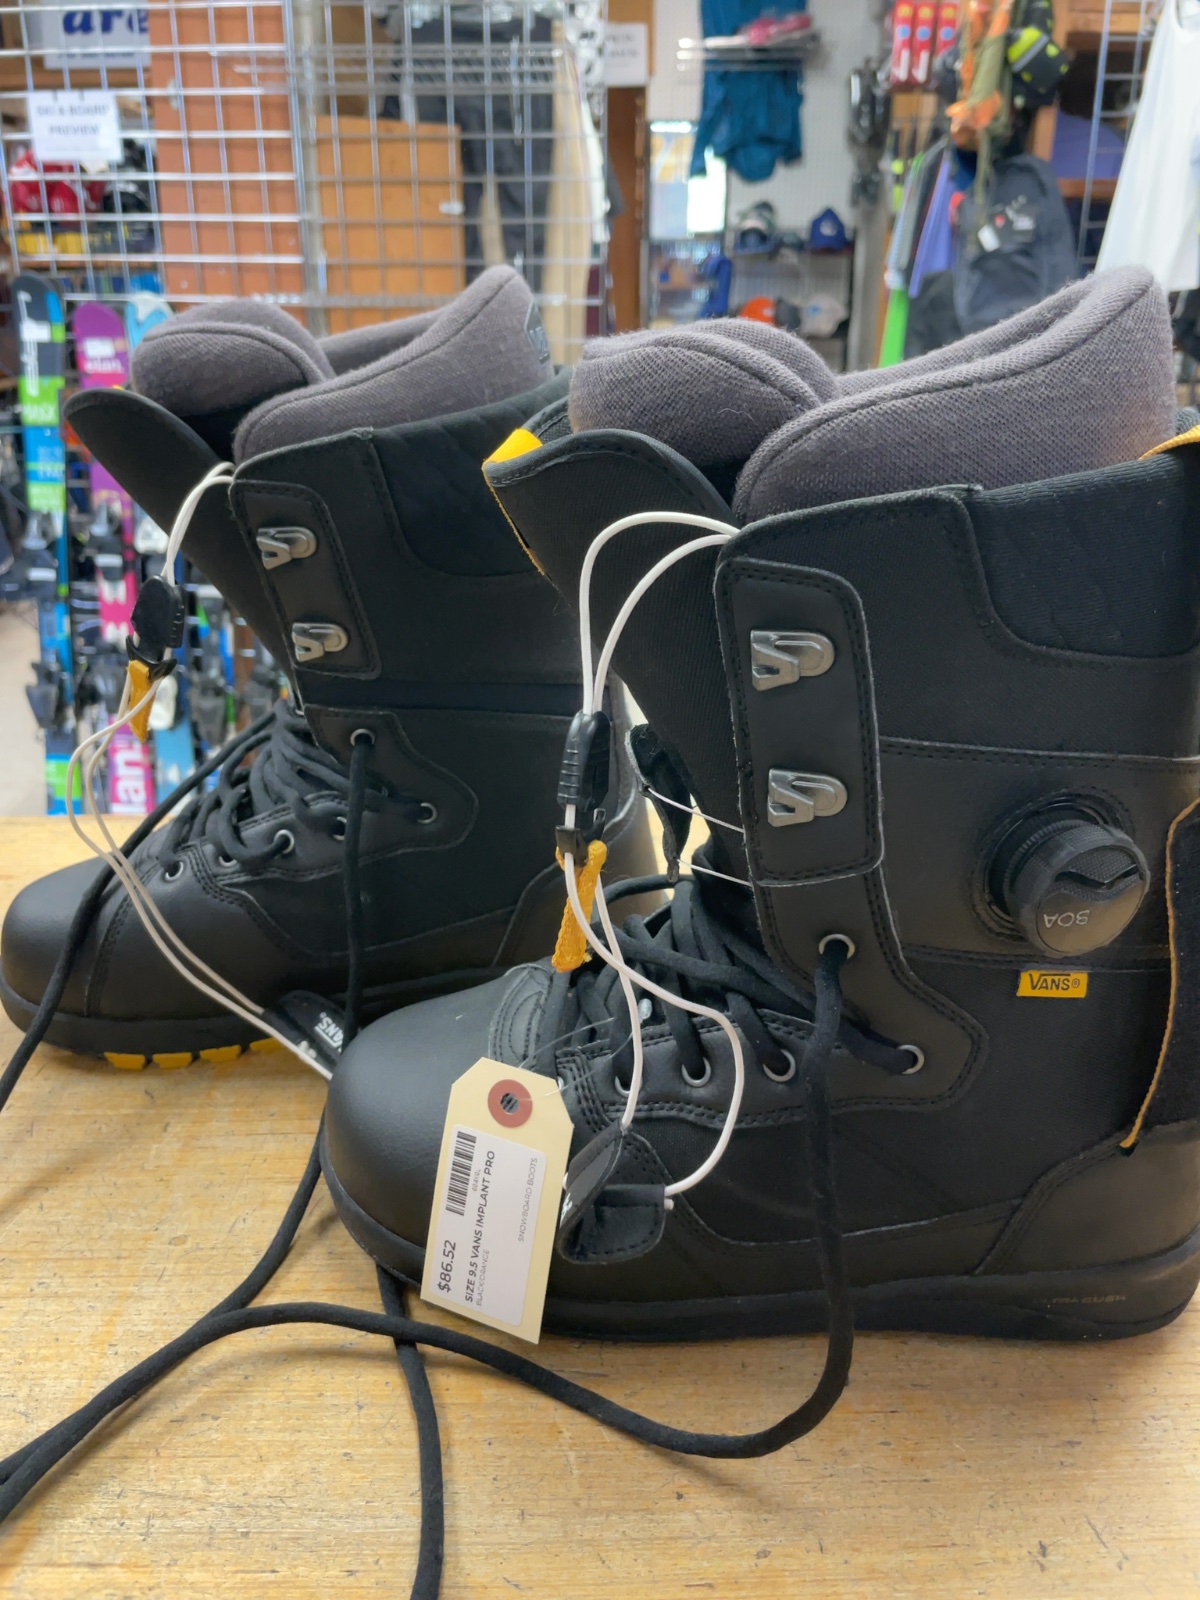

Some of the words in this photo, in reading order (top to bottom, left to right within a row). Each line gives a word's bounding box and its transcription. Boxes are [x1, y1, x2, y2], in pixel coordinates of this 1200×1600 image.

[1043, 909, 1090, 929] BOA
[483, 1150, 495, 1176] PRO
[475, 1176, 491, 1228] IMPLANT
[517, 1187, 533, 1243] SNOWBOARD
[527, 1157, 538, 1186] BOOTS
[471, 1229, 483, 1259] VANS
[437, 1239, 456, 1293] $86.52
[468, 1260, 478, 1278] 9.5
[465, 1278, 476, 1303] SIZE
